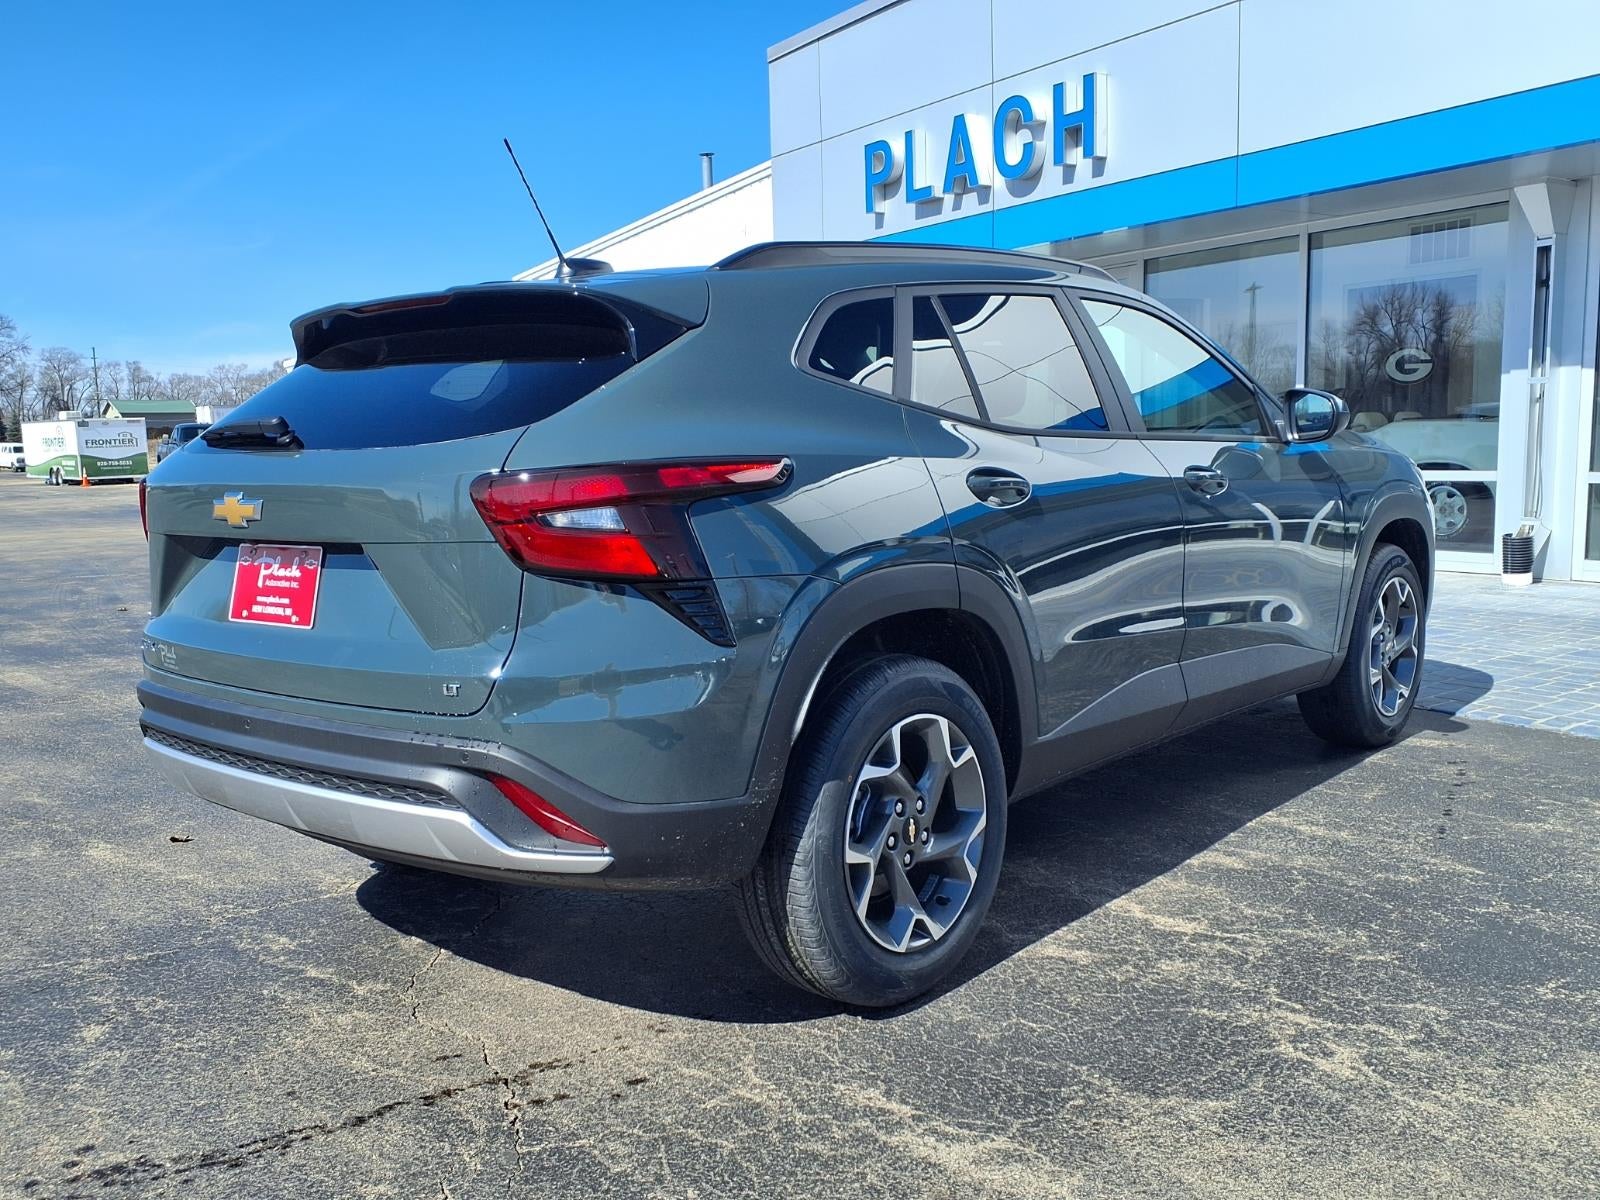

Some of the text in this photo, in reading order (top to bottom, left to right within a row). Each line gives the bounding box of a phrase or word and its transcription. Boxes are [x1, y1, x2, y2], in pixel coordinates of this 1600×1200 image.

[864, 72, 1106, 214] PLACH
[1385, 347, 1435, 384] G
[85, 438, 134, 446] FRONTIER
[254, 551, 301, 588] Plach
[252, 604, 262, 613] NEW
[285, 607, 292, 616] WI
[442, 683, 461, 697] LT
